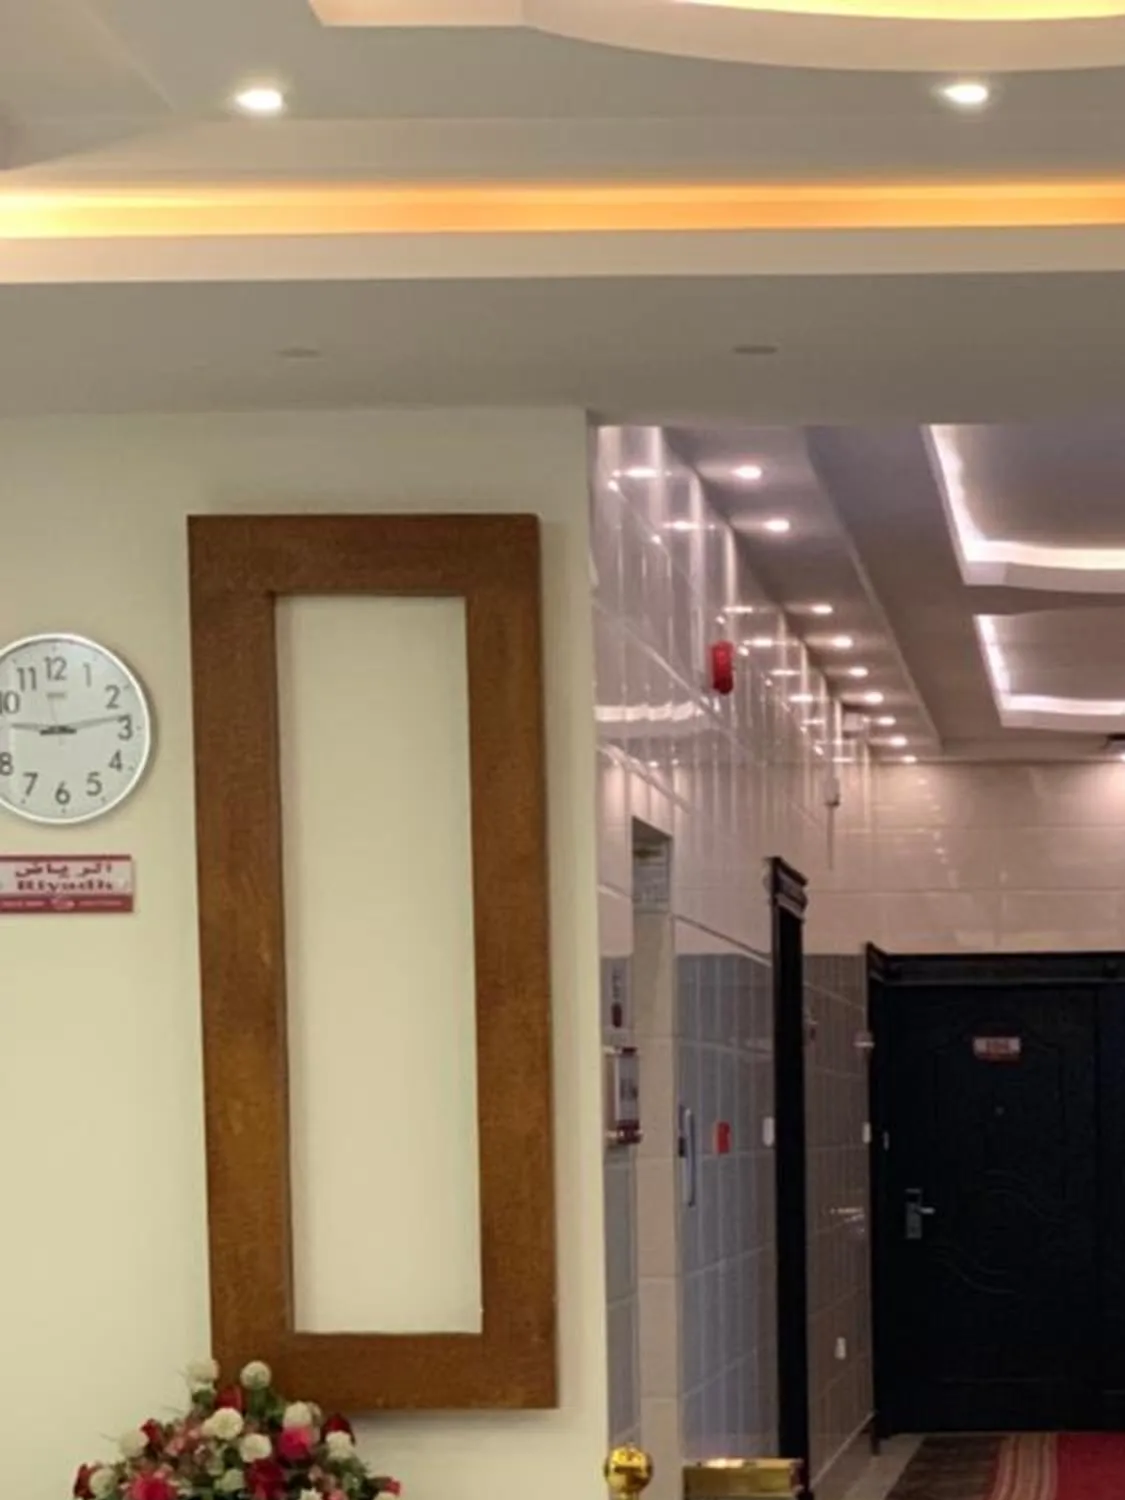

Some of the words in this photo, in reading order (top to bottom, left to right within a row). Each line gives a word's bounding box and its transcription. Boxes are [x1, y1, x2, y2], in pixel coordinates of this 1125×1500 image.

[16, 666, 37, 692] 11
[44, 657, 67, 681] 12
[83, 662, 92, 688] 1
[104, 684, 121, 710] 2
[117, 714, 134, 742] 3
[0, 752, 14, 777] 8
[108, 748, 124, 773] 4
[23, 772, 39, 797] 7
[54, 780, 71, 806] 6
[85, 771, 104, 797] 5
[16, 879, 113, 892] Riyadh
